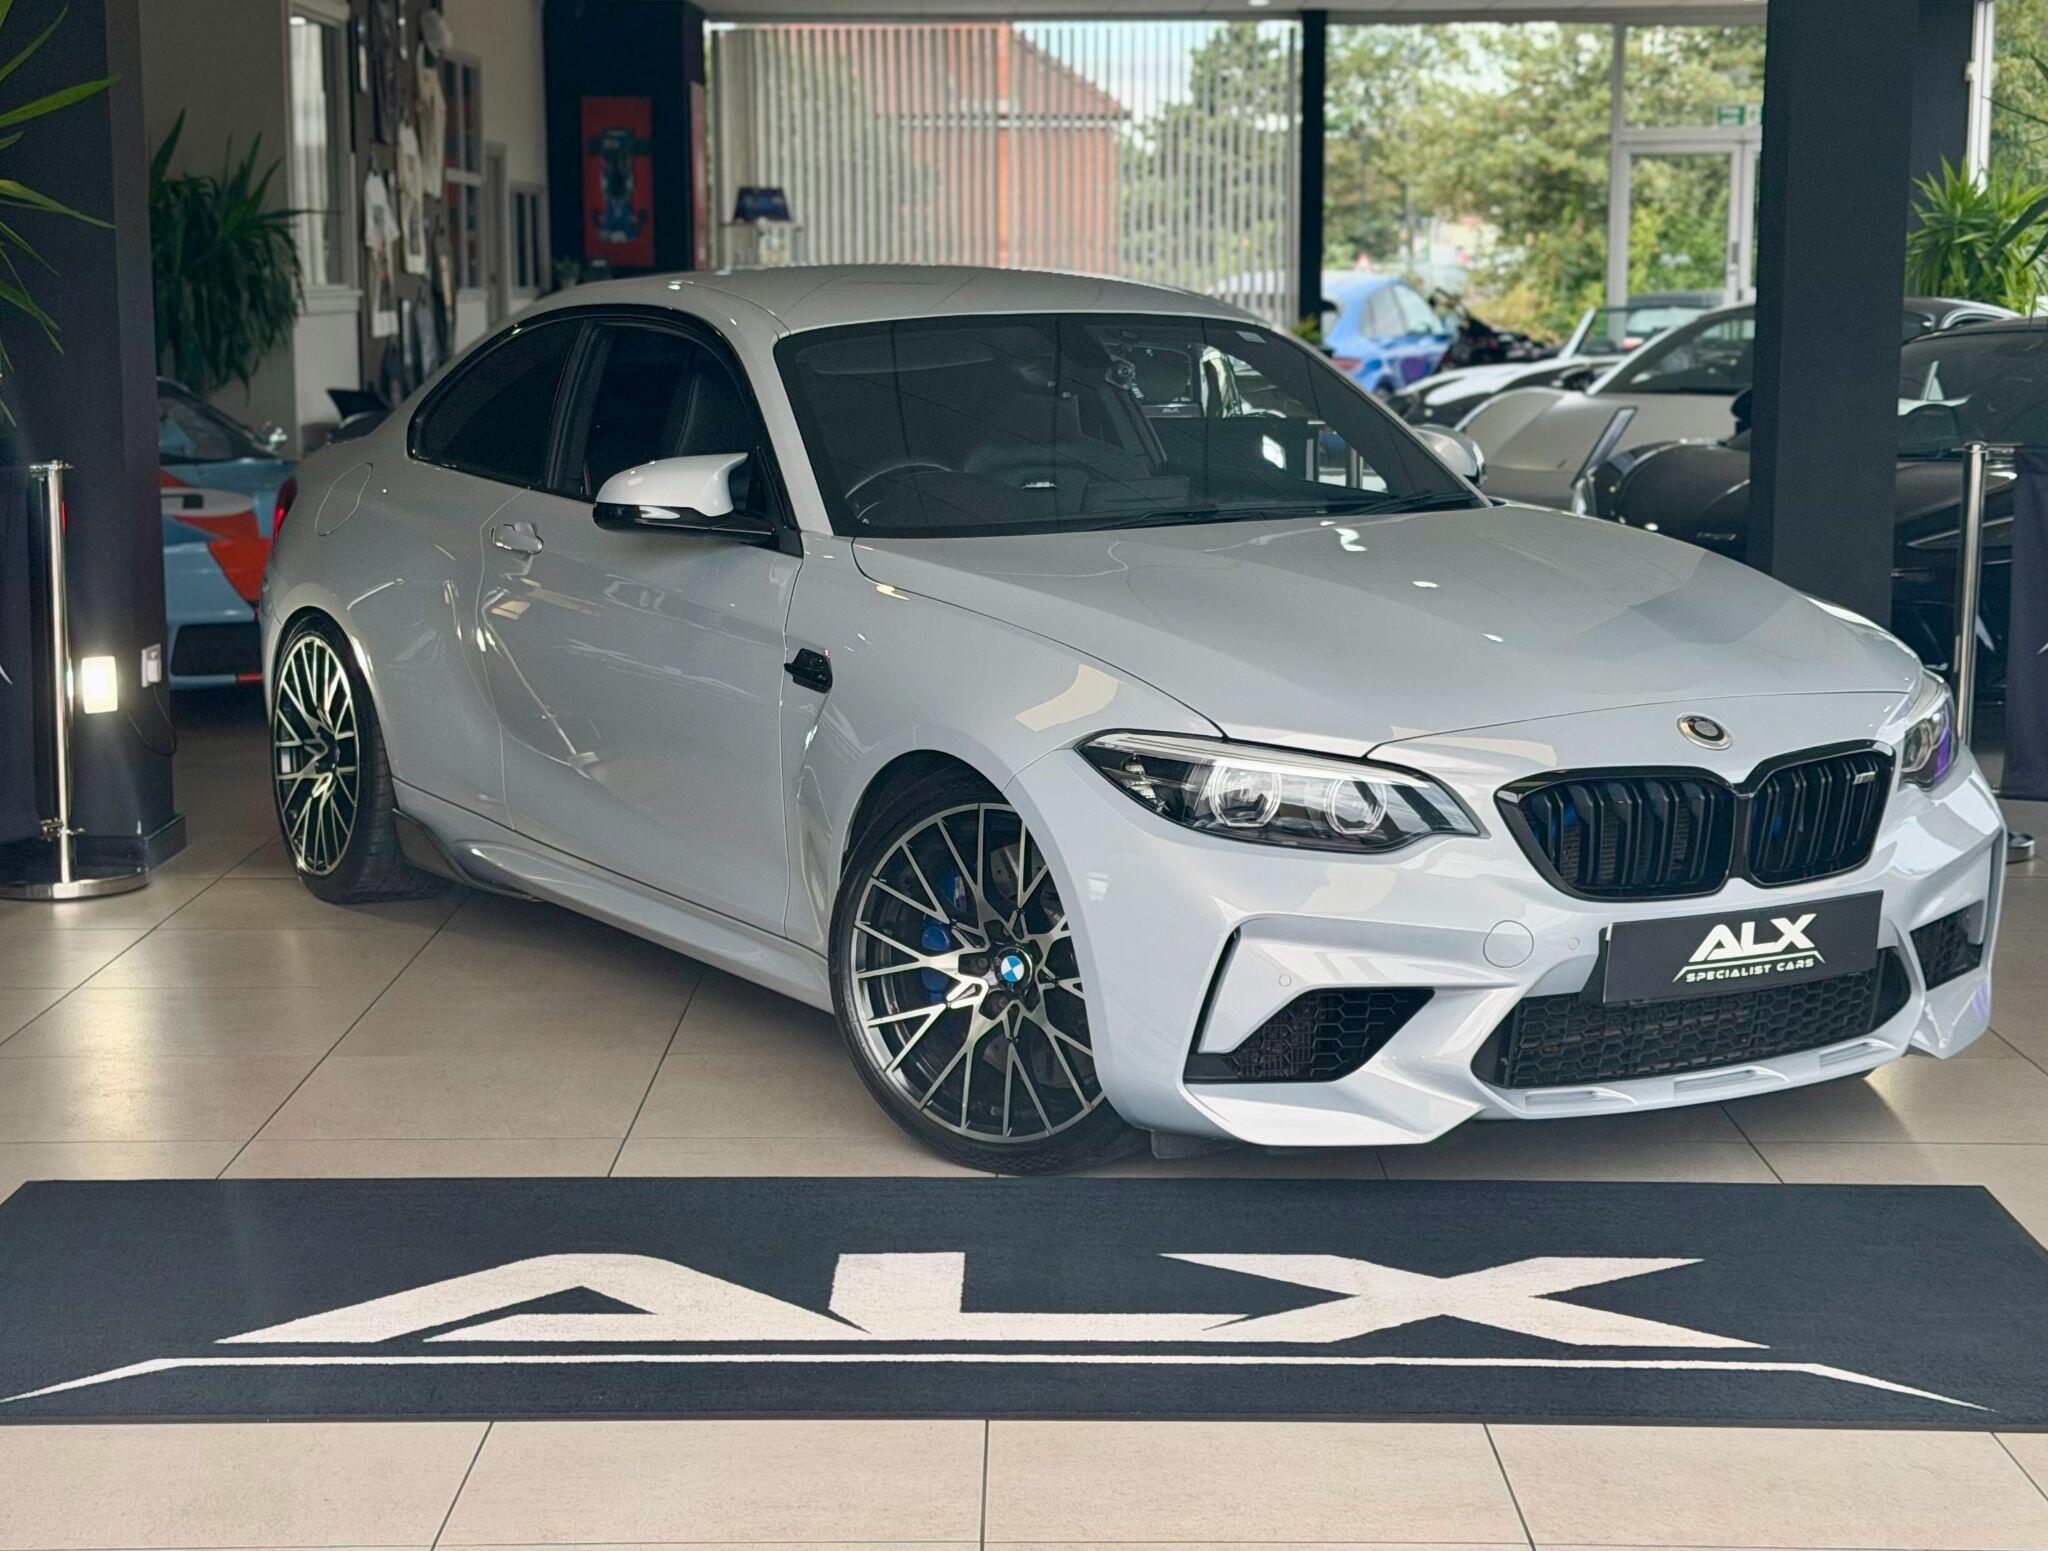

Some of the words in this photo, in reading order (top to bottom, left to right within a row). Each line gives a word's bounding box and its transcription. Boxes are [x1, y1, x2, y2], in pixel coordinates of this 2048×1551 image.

[1688, 912, 1817, 963] ALX
[1685, 963, 1772, 983] SPECIALIST
[1776, 957, 1815, 972] CARS
[213, 1251, 1771, 1350] ALX
